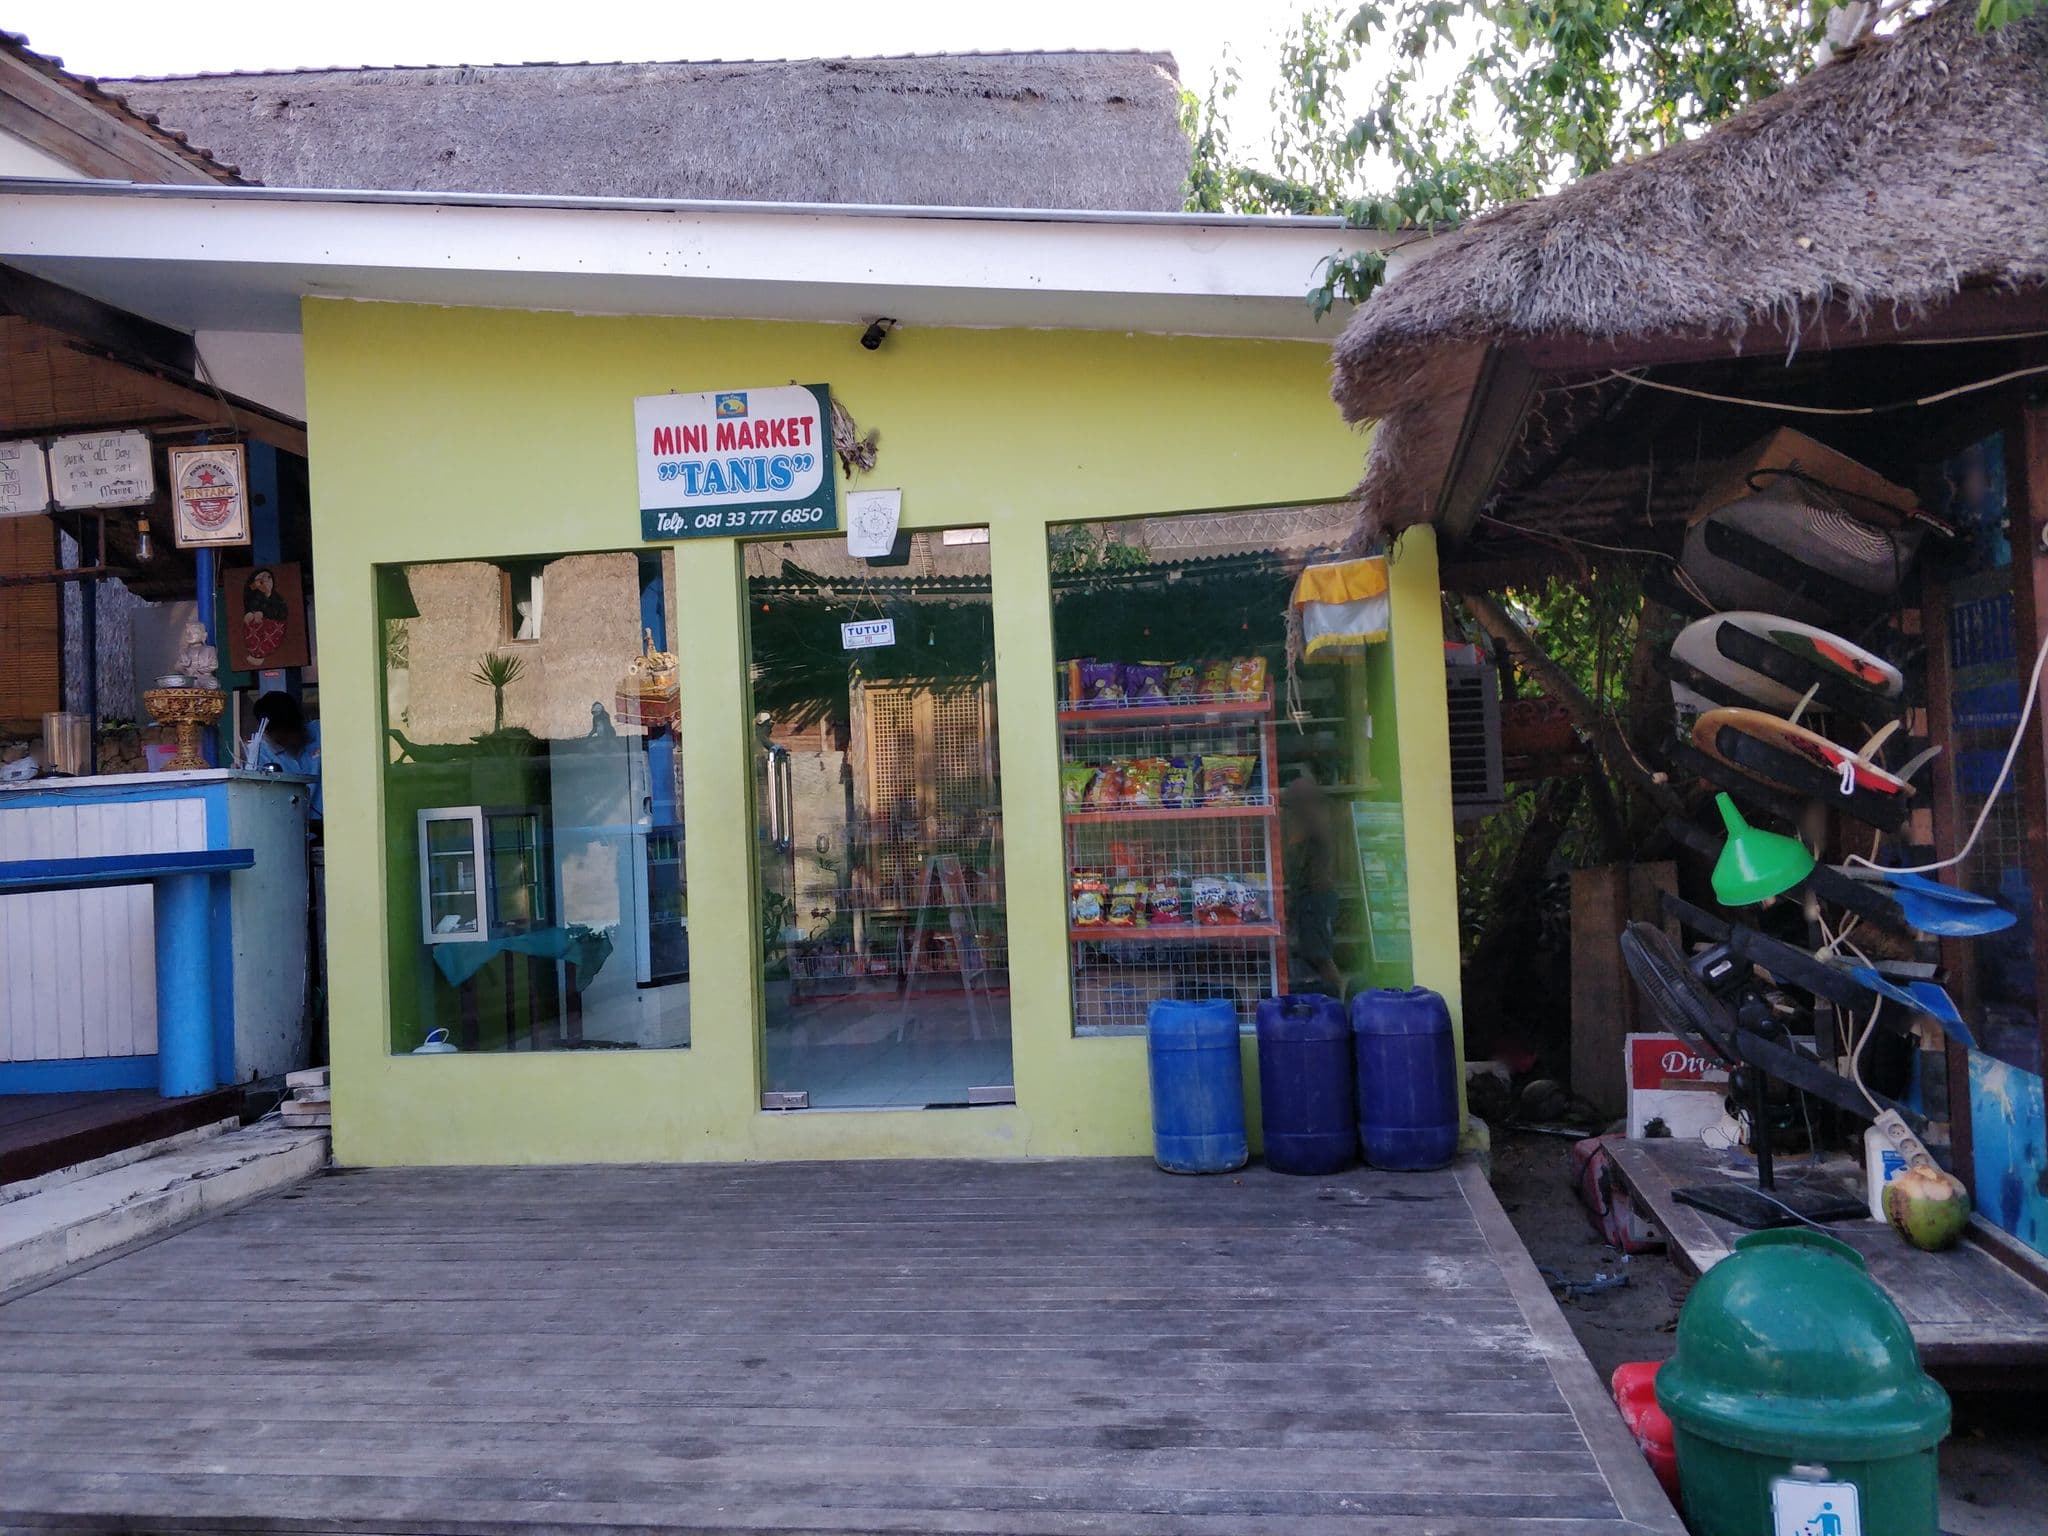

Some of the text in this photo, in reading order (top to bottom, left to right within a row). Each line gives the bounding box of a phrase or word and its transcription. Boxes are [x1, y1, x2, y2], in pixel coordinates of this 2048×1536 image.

[653, 416, 814, 456] MINI MARKET
[184, 487, 234, 499] BINTANG
[657, 507, 823, 534] Telp. 081 33 777 6850
[847, 624, 888, 636] TUTUP
[1661, 1051, 1716, 1073] Div
